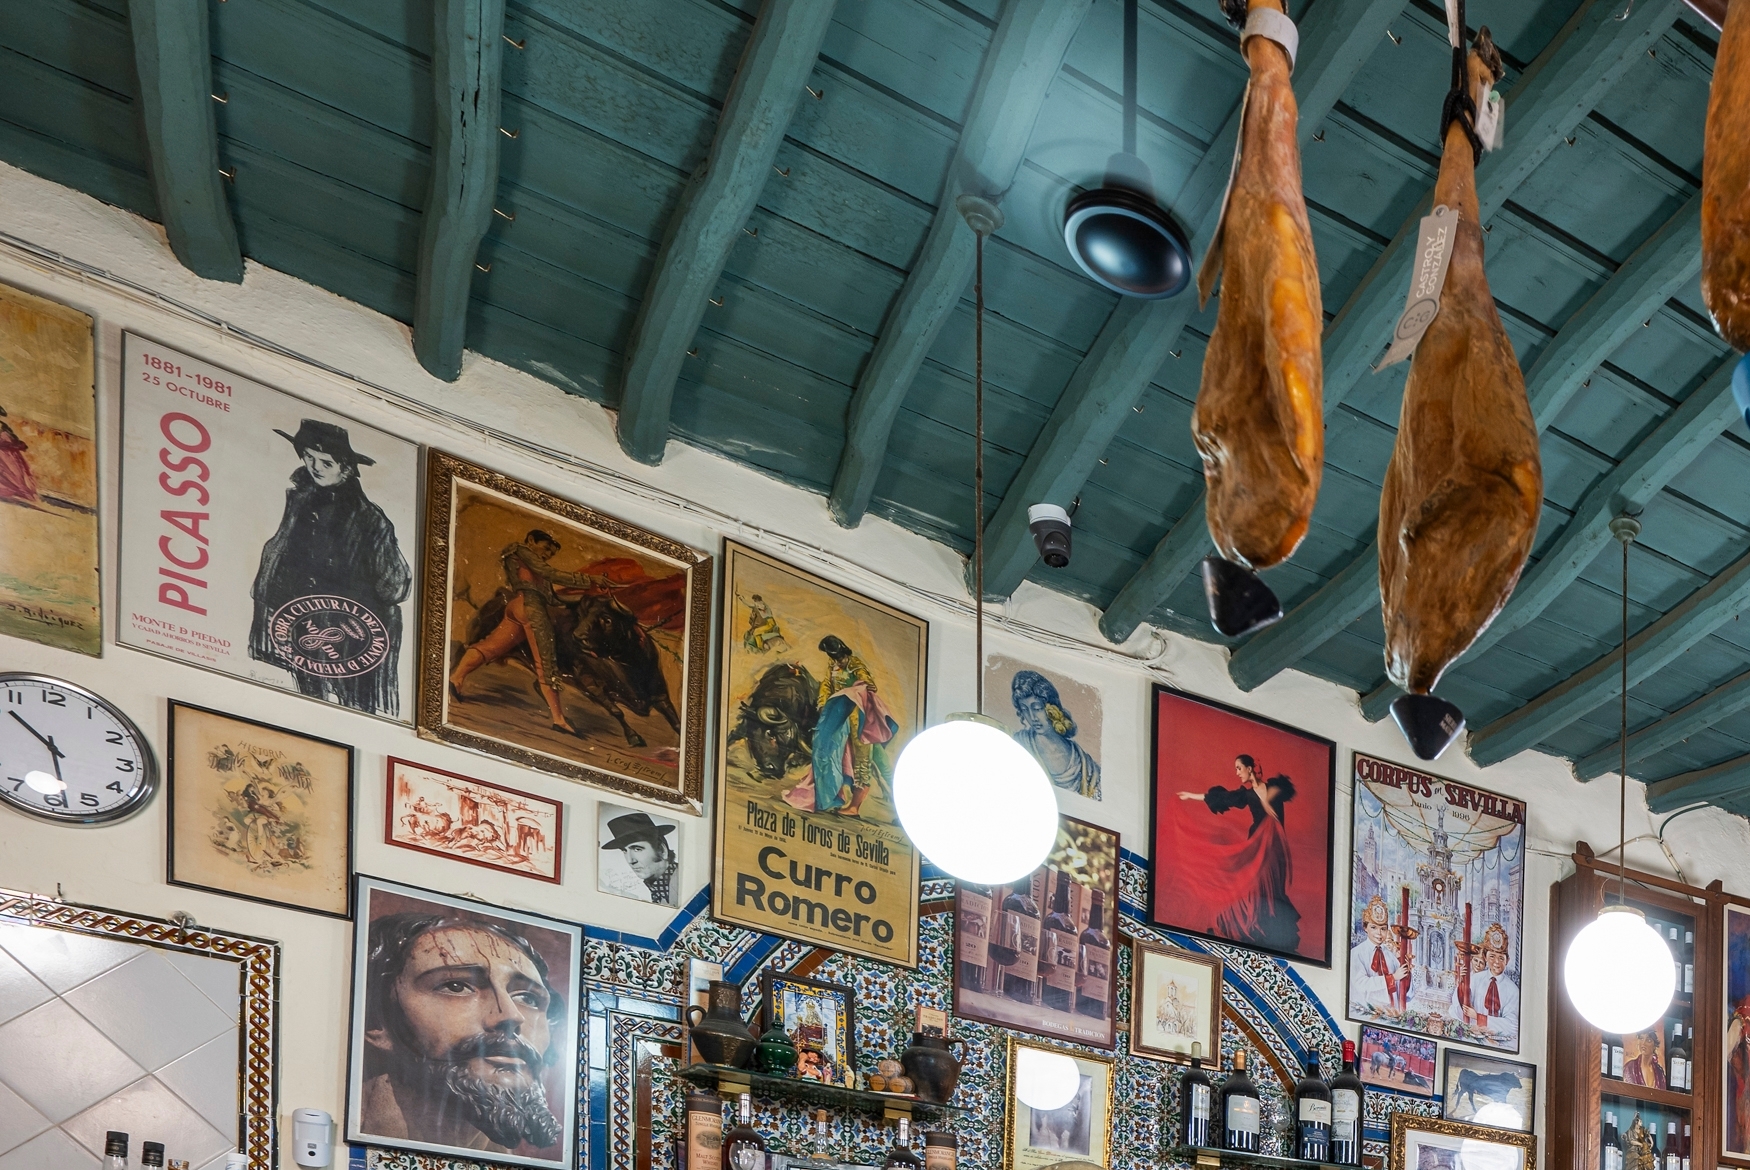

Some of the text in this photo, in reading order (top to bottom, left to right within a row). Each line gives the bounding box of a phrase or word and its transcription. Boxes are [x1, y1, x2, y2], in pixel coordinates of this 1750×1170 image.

[1416, 236, 1435, 298] CASTRO Y
[143, 354, 232, 397] 1881-1981
[142, 372, 230, 413] 25 OCTUBRE
[159, 411, 211, 616] PICASSO
[290, 599, 360, 616] CULTURAL
[42, 690, 66, 707] 12
[106, 730, 124, 746] 2
[116, 758, 134, 772] 3
[80, 793, 99, 808] 5
[106, 781, 124, 793] 4
[1357, 758, 1432, 798] CORPUS
[1445, 783, 1524, 824] SEVILLA
[1411, 800, 1470, 821] Junio 1996
[747, 801, 776, 832] Plaza
[782, 812, 795, 838] de
[801, 817, 832, 849] Toros
[838, 829, 850, 854] de
[856, 834, 889, 866] Sevilla
[758, 846, 877, 905] Curro
[736, 872, 894, 943] Romero
[1042, 1020, 1069, 1031] BODEGAS
